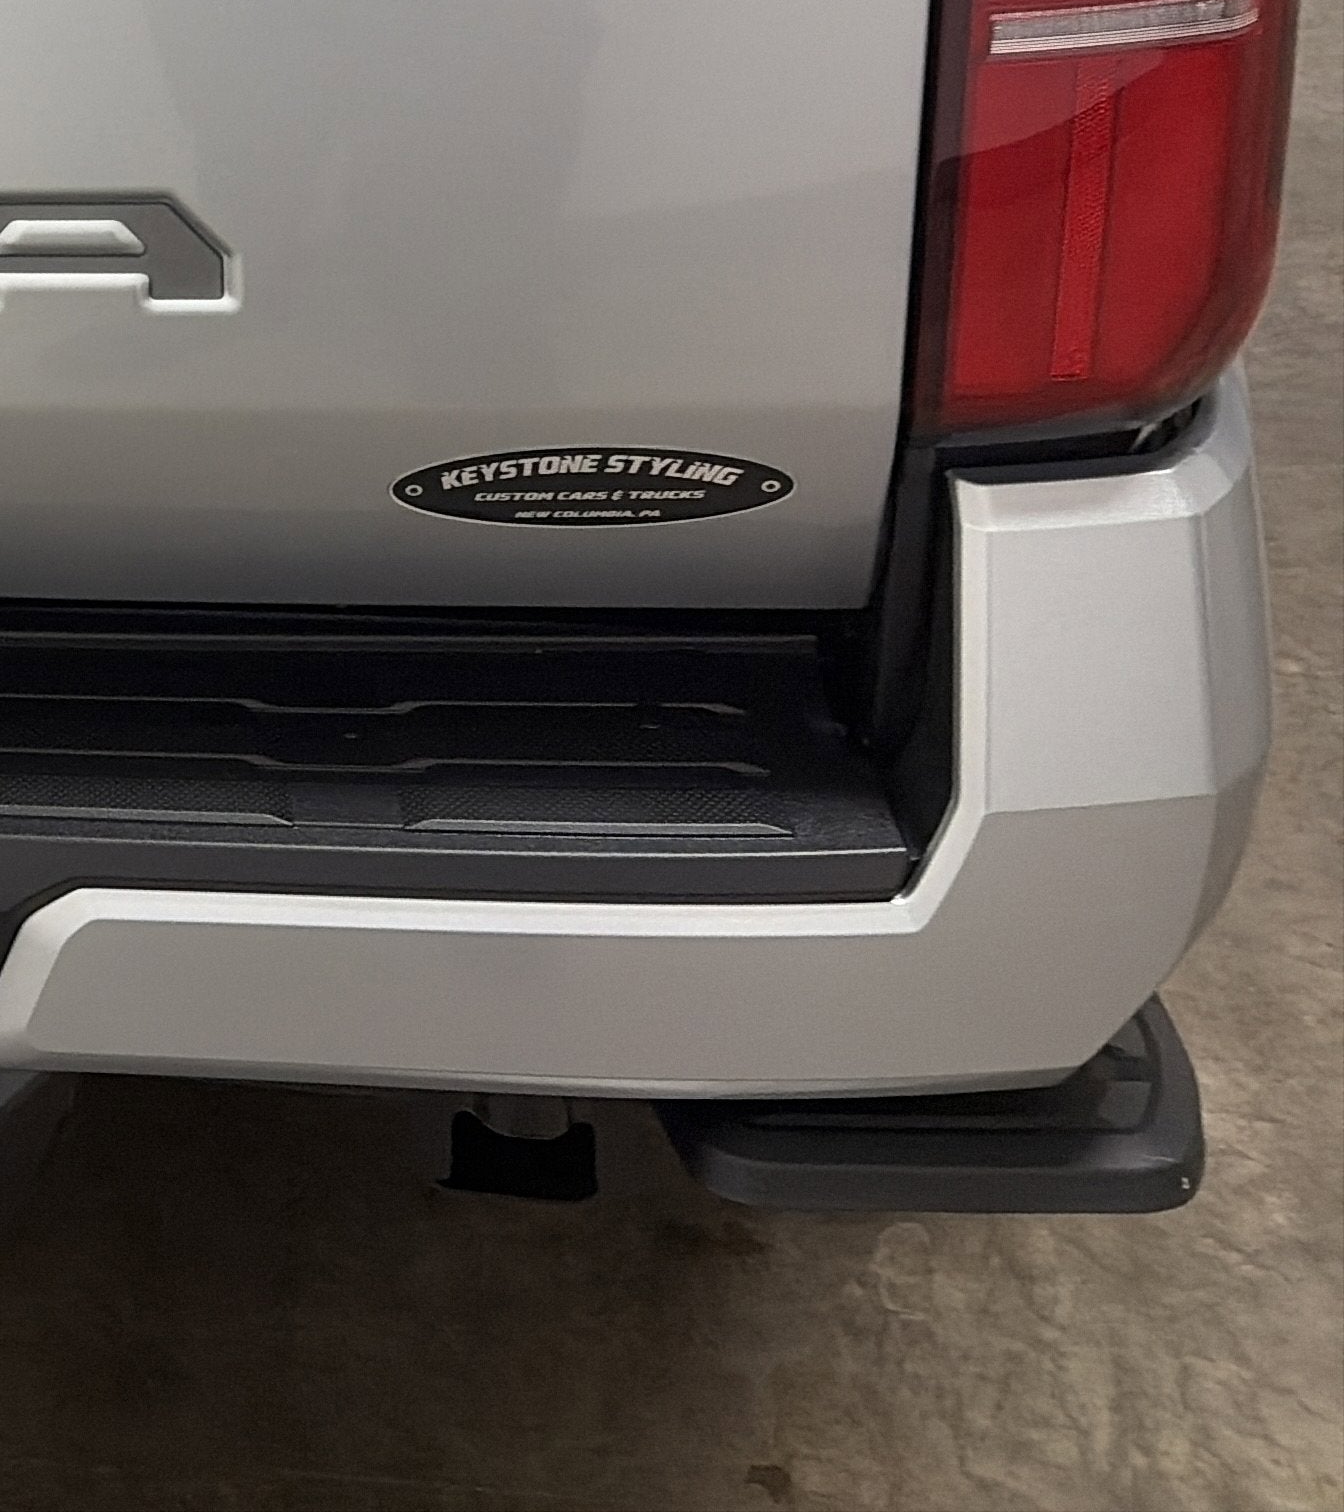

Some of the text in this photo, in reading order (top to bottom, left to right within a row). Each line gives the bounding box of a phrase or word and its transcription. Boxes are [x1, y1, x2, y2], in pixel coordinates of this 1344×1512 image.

[441, 454, 602, 490] KEYSTONE
[474, 490, 707, 502] CUSTOM CARS & TRUCKS
[514, 510, 552, 518] NEW
[639, 509, 662, 517] PA
